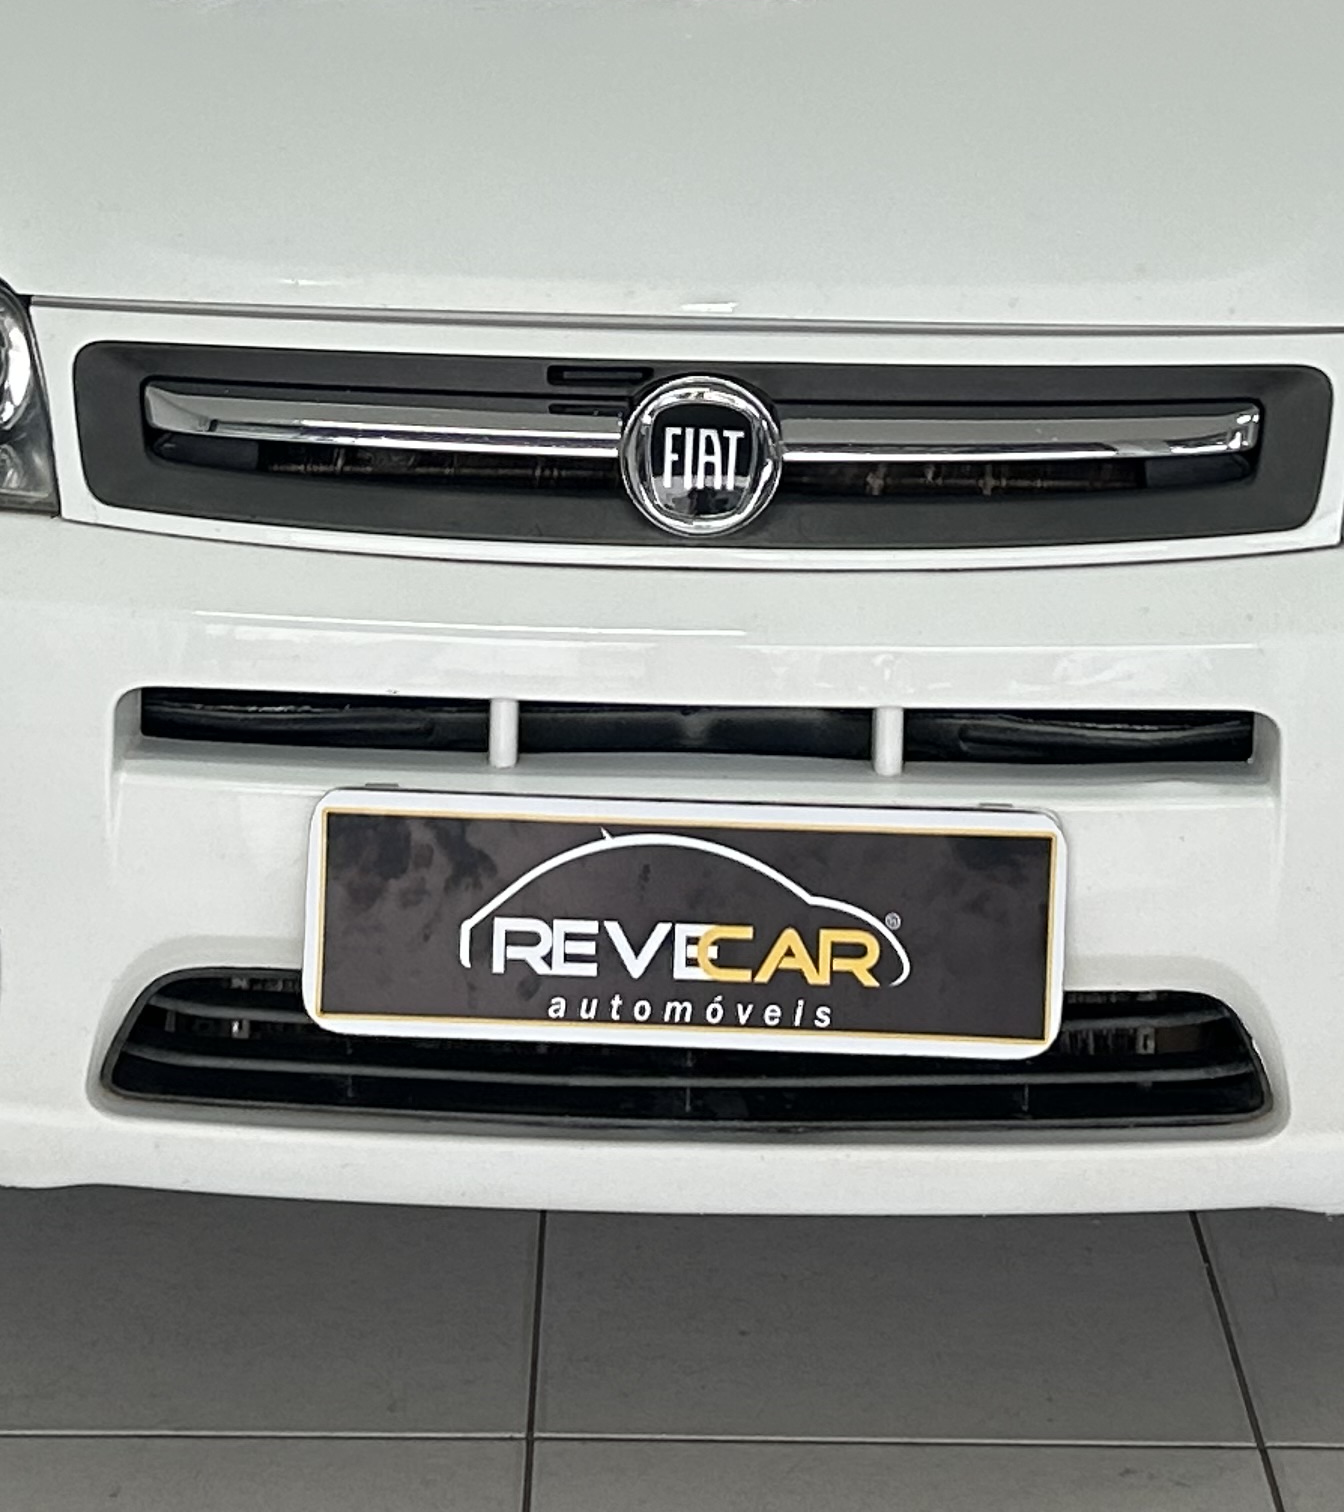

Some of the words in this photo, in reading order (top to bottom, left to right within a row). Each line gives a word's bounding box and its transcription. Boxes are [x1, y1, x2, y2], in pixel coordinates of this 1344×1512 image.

[662, 426, 745, 491] FIAT
[491, 916, 881, 988] REVECAR
[547, 992, 833, 1029] automóveis
